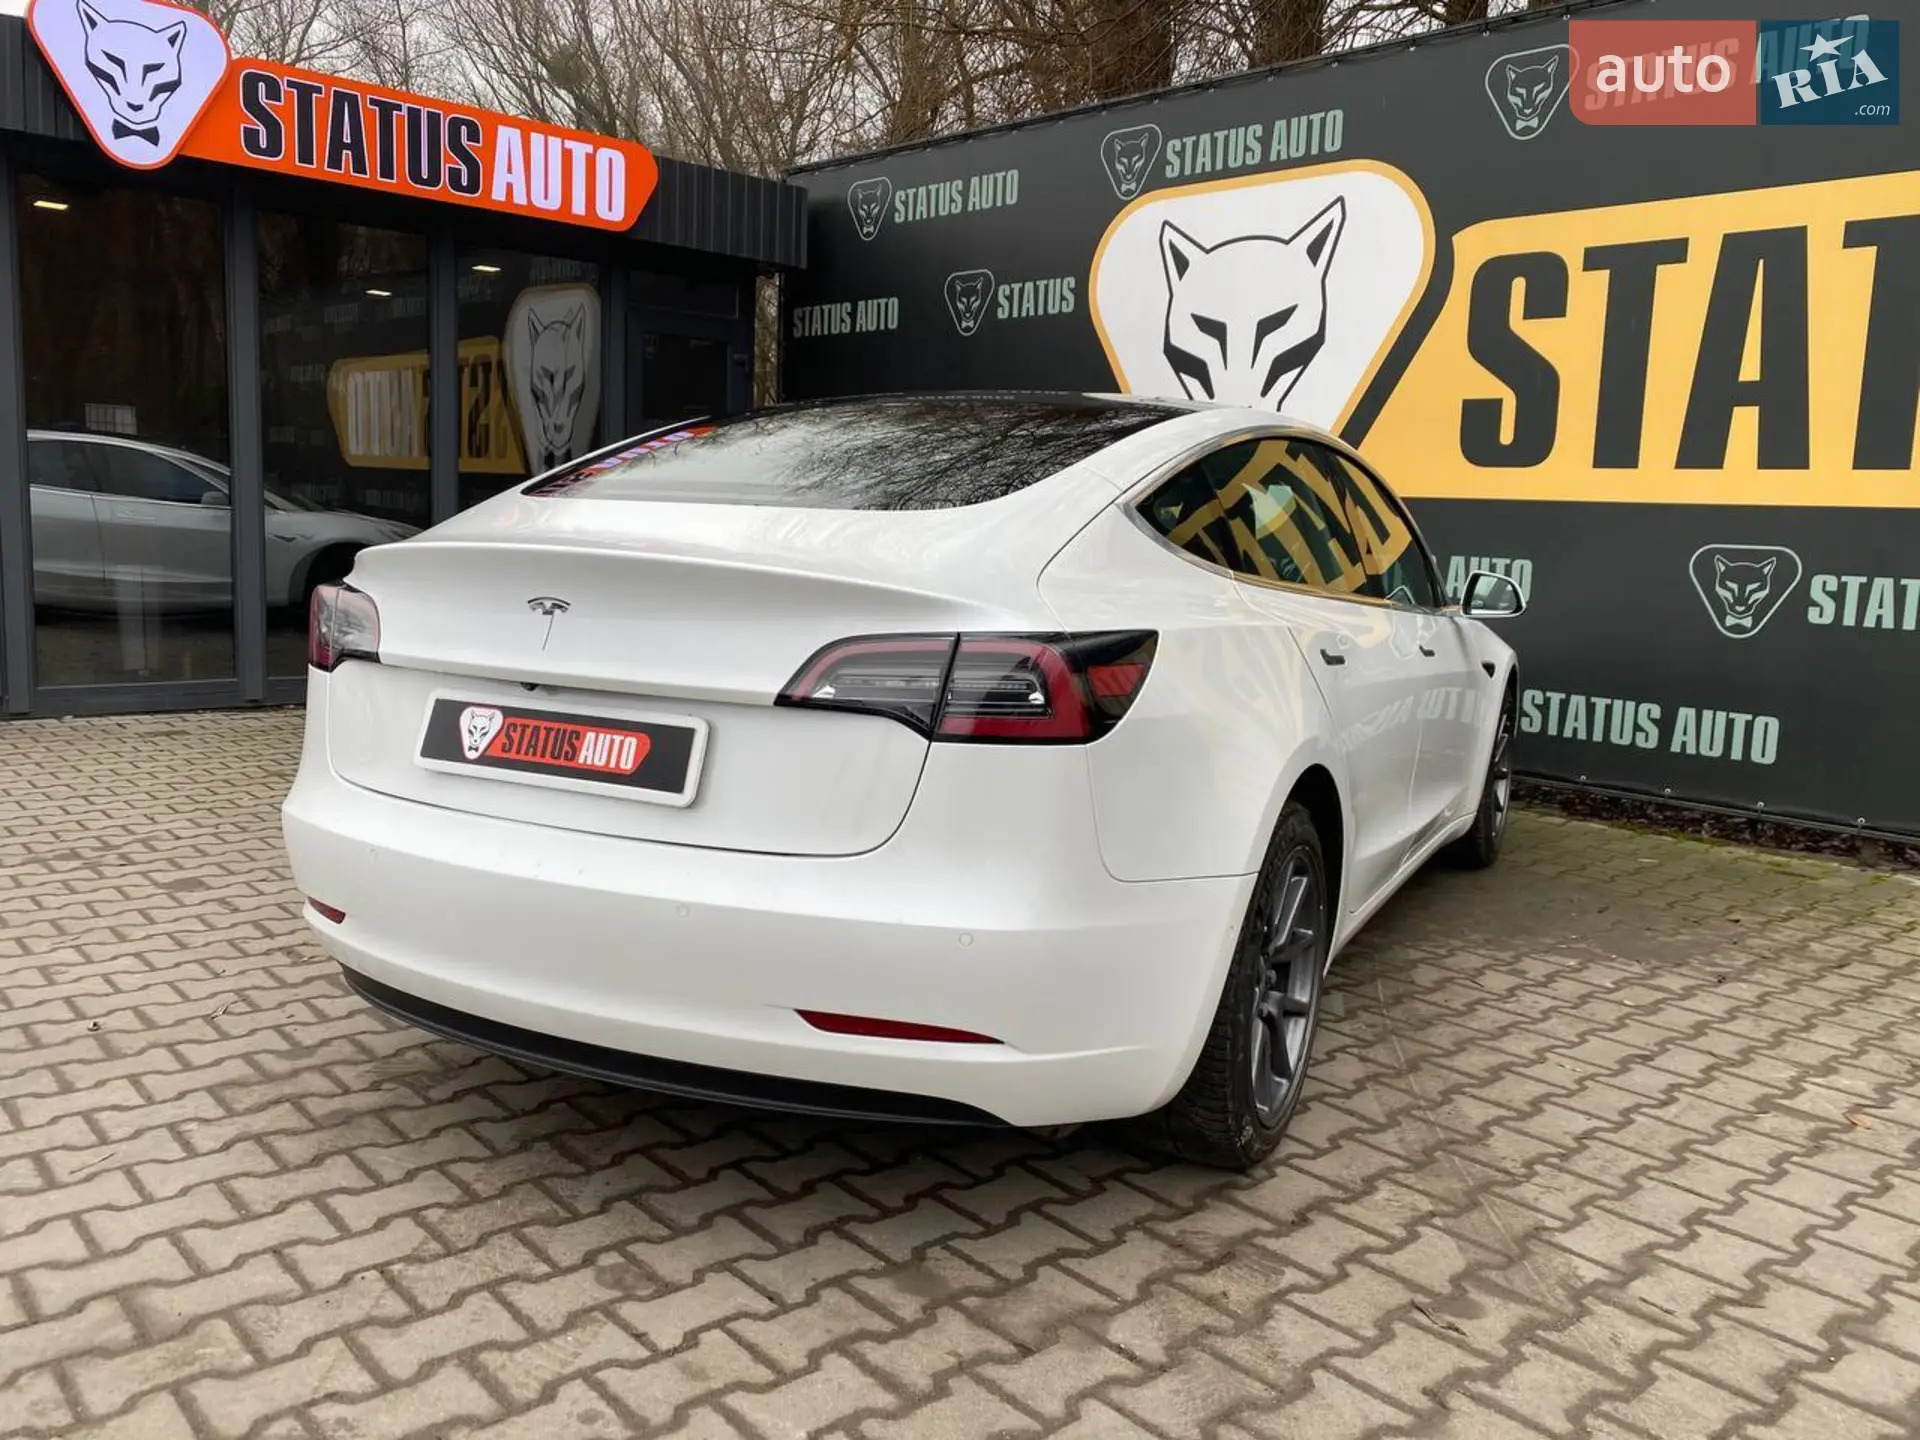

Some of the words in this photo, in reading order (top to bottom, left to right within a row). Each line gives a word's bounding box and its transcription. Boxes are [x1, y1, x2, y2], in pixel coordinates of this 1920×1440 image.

[239, 69, 483, 198] STATUS
[491, 124, 626, 223] AUTO
[1165, 123, 1262, 179] STATUS
[1269, 109, 1344, 163] AUTO
[894, 182, 963, 224] STATUS
[967, 169, 1020, 211] AUTO
[793, 302, 852, 339] STATUS
[855, 296, 899, 333] AUTO
[997, 276, 1076, 319] STATUS
[1459, 213, 1920, 471] STAT
[1807, 573, 1920, 630] STAT
[500, 721, 580, 762] STATUS
[578, 731, 637, 770] AUTO
[1520, 689, 1660, 749] STATUS
[1670, 707, 1780, 766] AUTO
